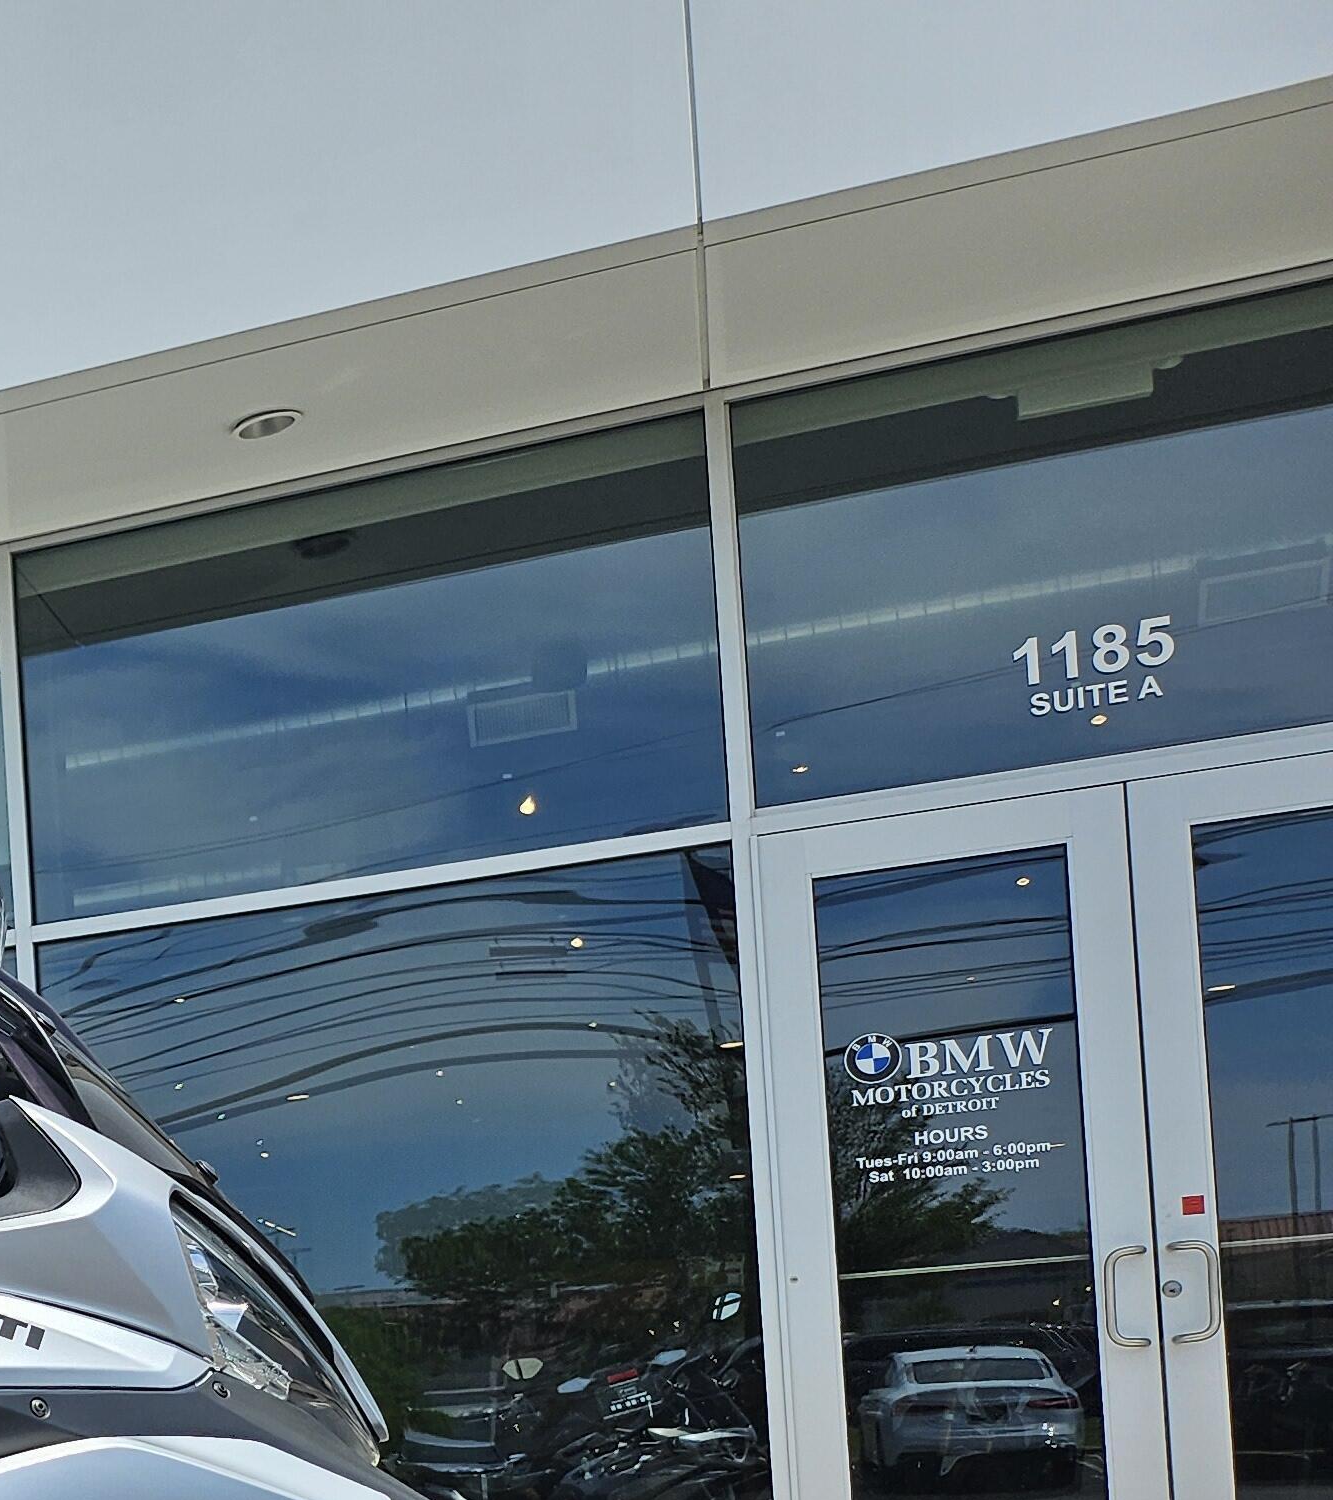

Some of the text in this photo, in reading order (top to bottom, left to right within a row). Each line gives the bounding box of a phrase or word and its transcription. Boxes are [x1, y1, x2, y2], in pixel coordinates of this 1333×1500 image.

[1012, 615, 1175, 686] 1185
[1030, 675, 1164, 716] SUITE A
[905, 1028, 1054, 1079] BMW
[851, 1069, 1051, 1108] MOTORCYCLES
[901, 1097, 1000, 1119] of DETROIT
[914, 1125, 989, 1146] HOURS
[856, 1154, 919, 1170] Tues-Fri
[922, 1148, 979, 1163] 9:00am
[992, 1141, 1051, 1157] 6:00pm
[869, 1170, 895, 1184] Sat
[903, 1164, 968, 1180] 10:00am
[981, 1158, 1040, 1173] 3:00pm
